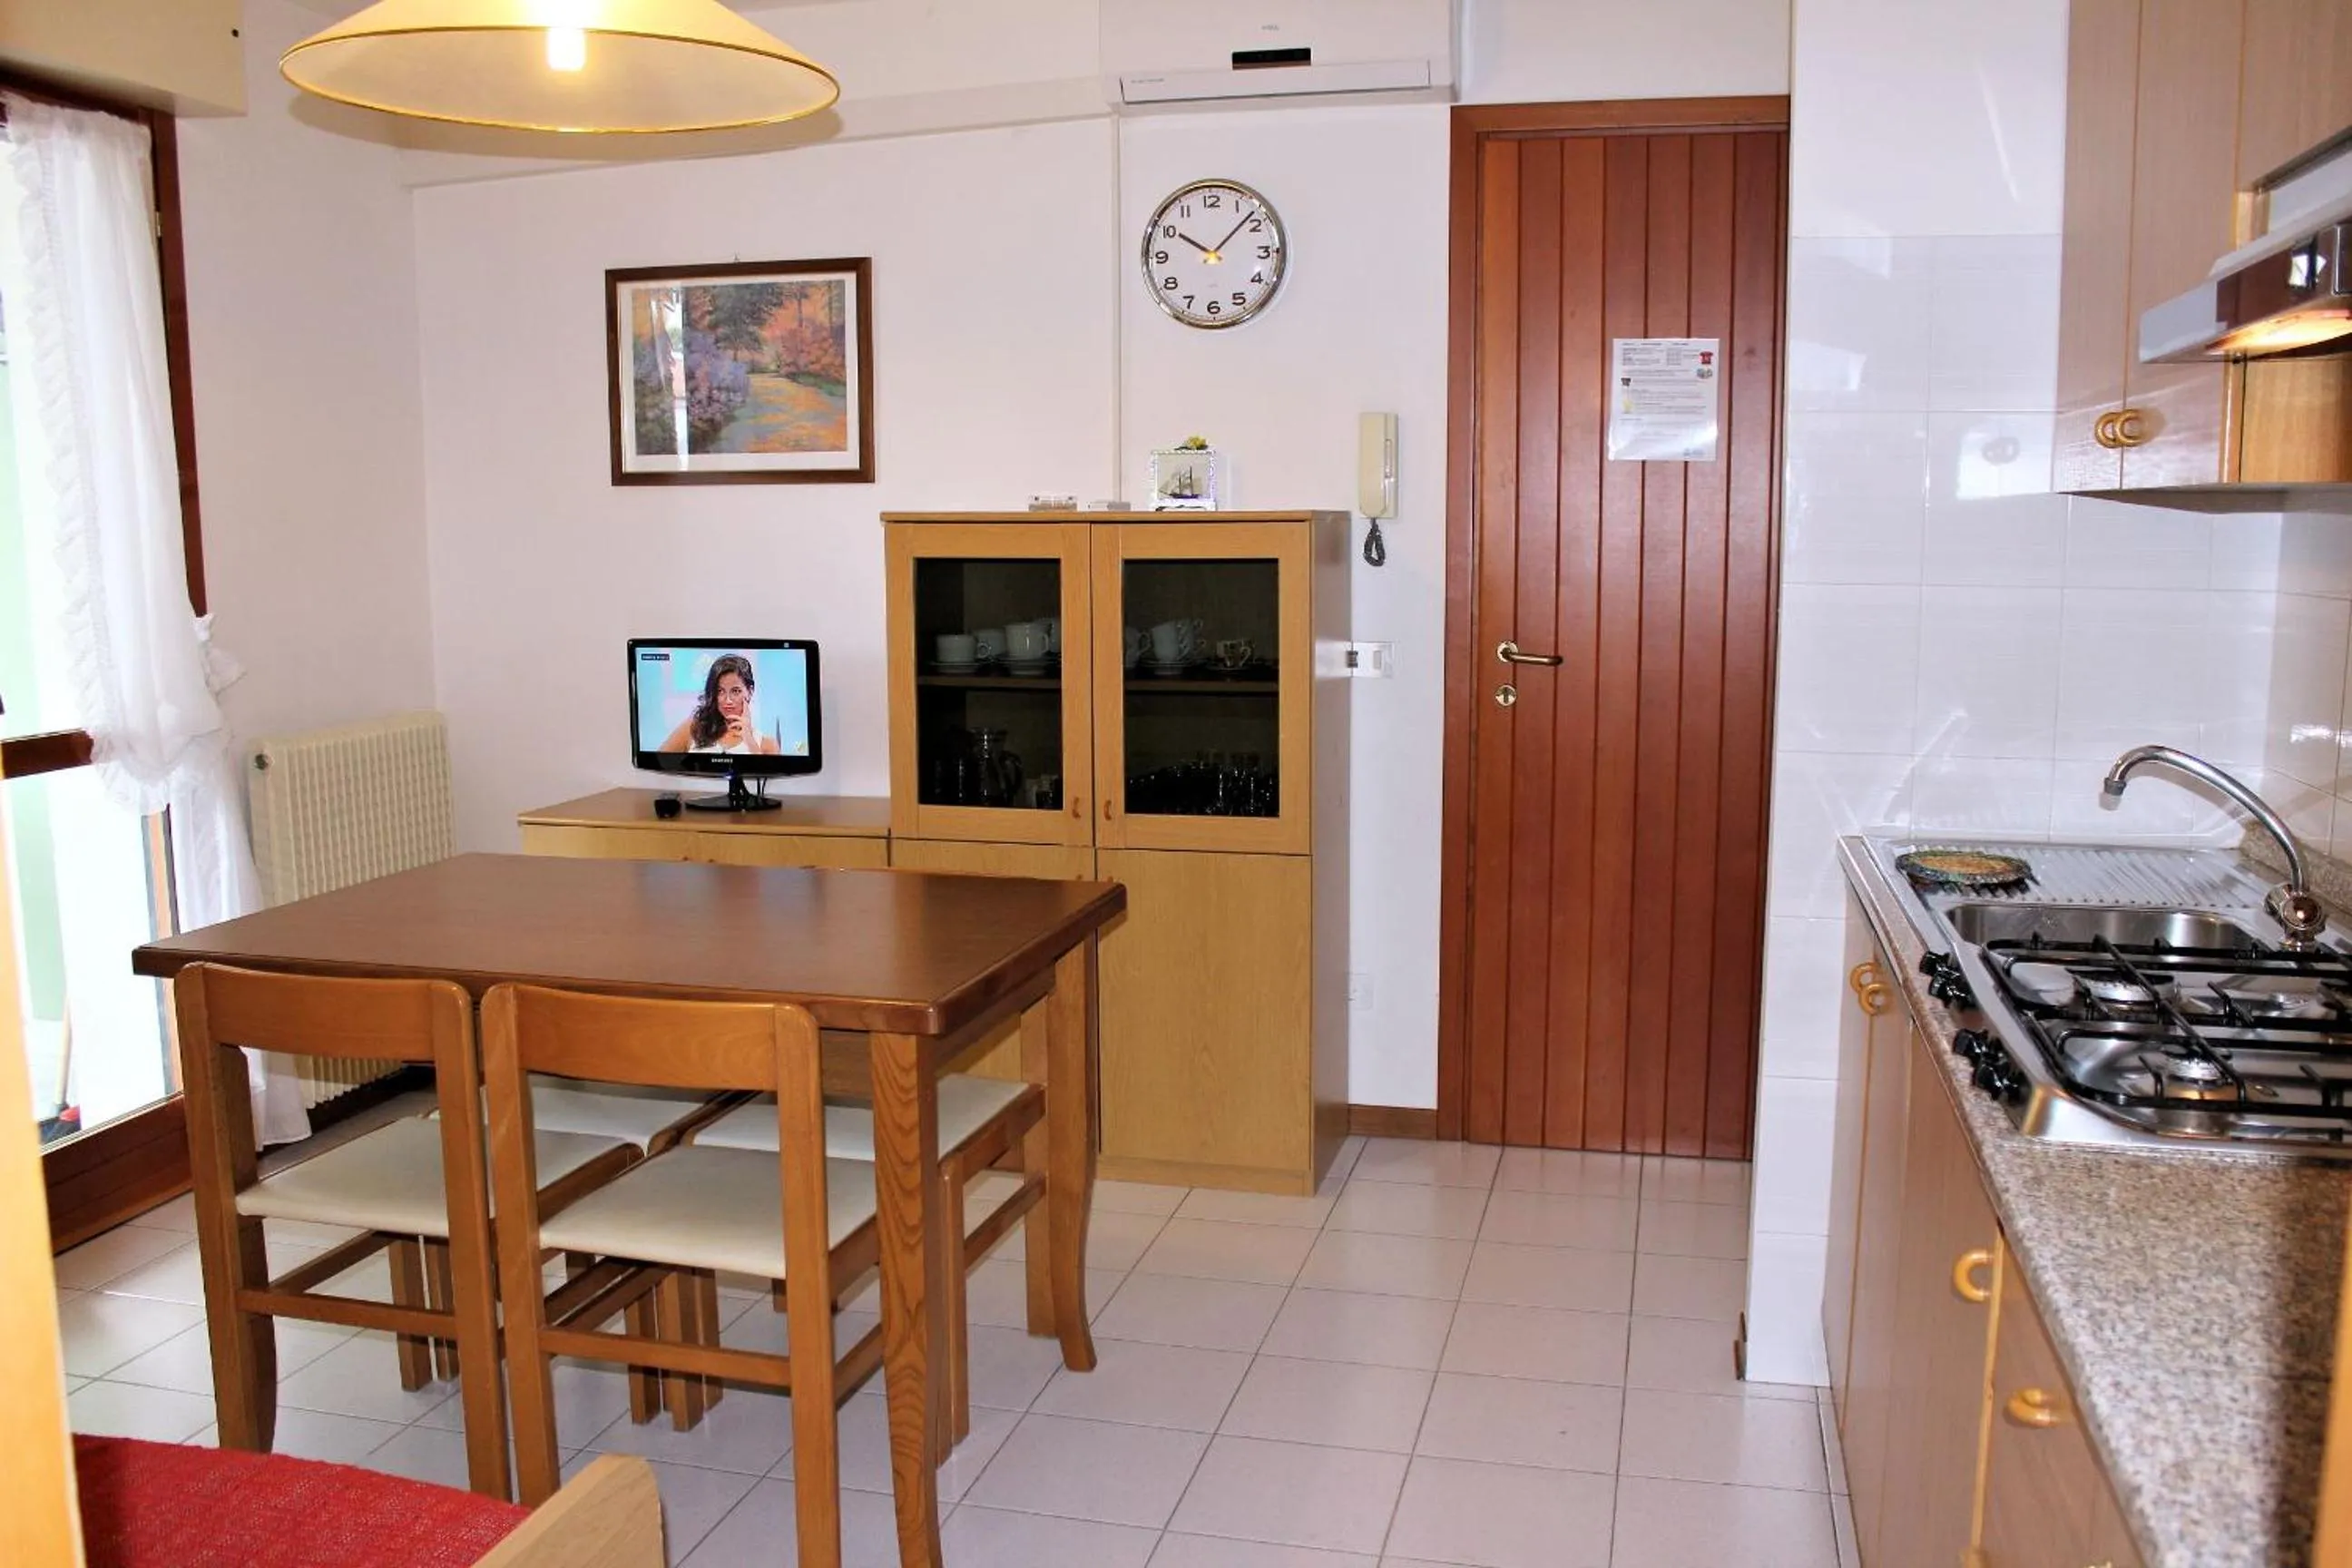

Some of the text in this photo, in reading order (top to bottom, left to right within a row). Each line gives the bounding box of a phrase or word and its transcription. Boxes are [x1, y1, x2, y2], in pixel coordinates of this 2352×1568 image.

[1203, 195, 1220, 208] 12
[1235, 201, 1240, 213] 1
[1181, 205, 1191, 218] 11
[1162, 225, 1176, 238] 10
[1249, 219, 1262, 232] 2
[1155, 250, 1169, 264] 9
[1257, 246, 1270, 259] 3
[1164, 277, 1178, 290] 8
[1250, 271, 1263, 284] 4
[1183, 295, 1195, 309] 7
[1232, 292, 1246, 306] 5
[1207, 301, 1220, 314] 6
